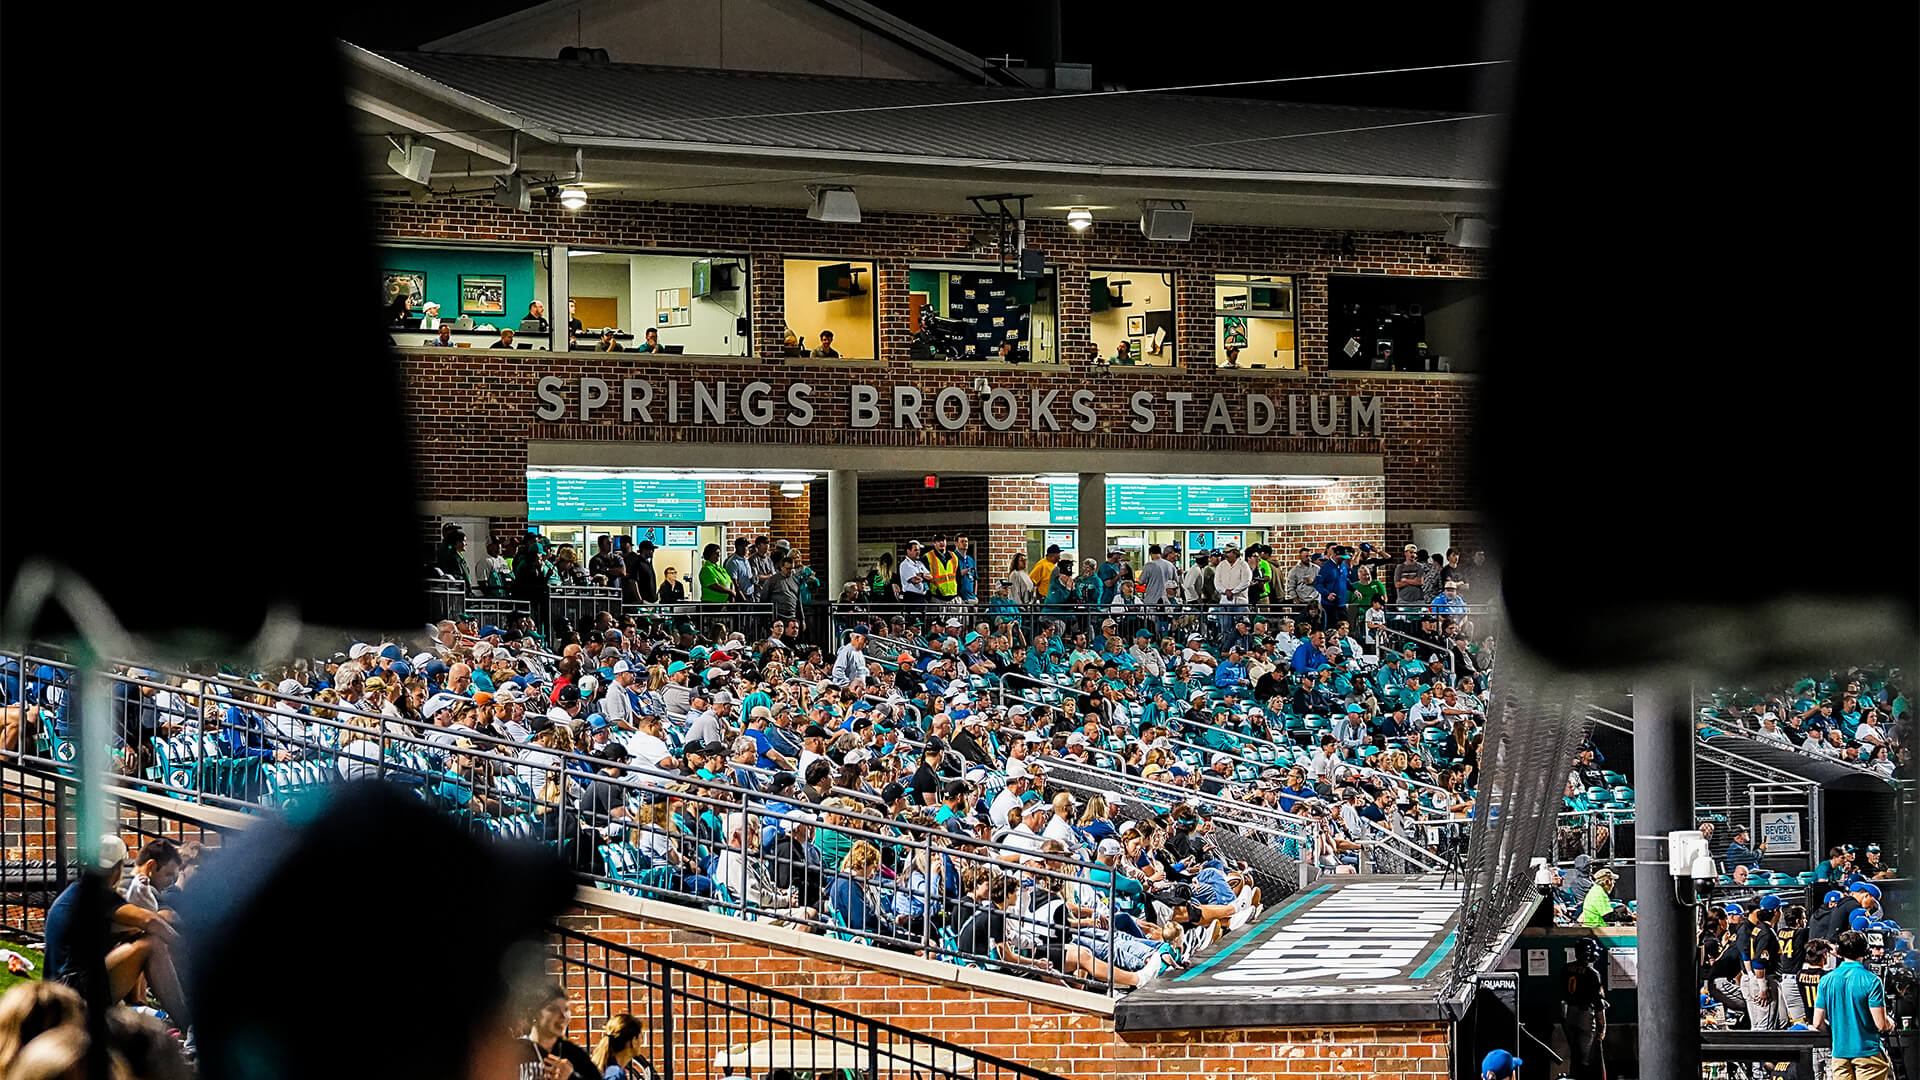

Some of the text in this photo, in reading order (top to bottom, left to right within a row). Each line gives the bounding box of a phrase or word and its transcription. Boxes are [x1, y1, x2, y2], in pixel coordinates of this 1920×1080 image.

[536, 376, 1383, 436] SPRINGS BROOKS STADIUM
[1765, 825, 1796, 835] BEVERLY
[1770, 834, 1792, 842] HOMES
[1210, 882, 1483, 982] CHANTICLEERS
[1480, 980, 1516, 990] AQUAFINA
